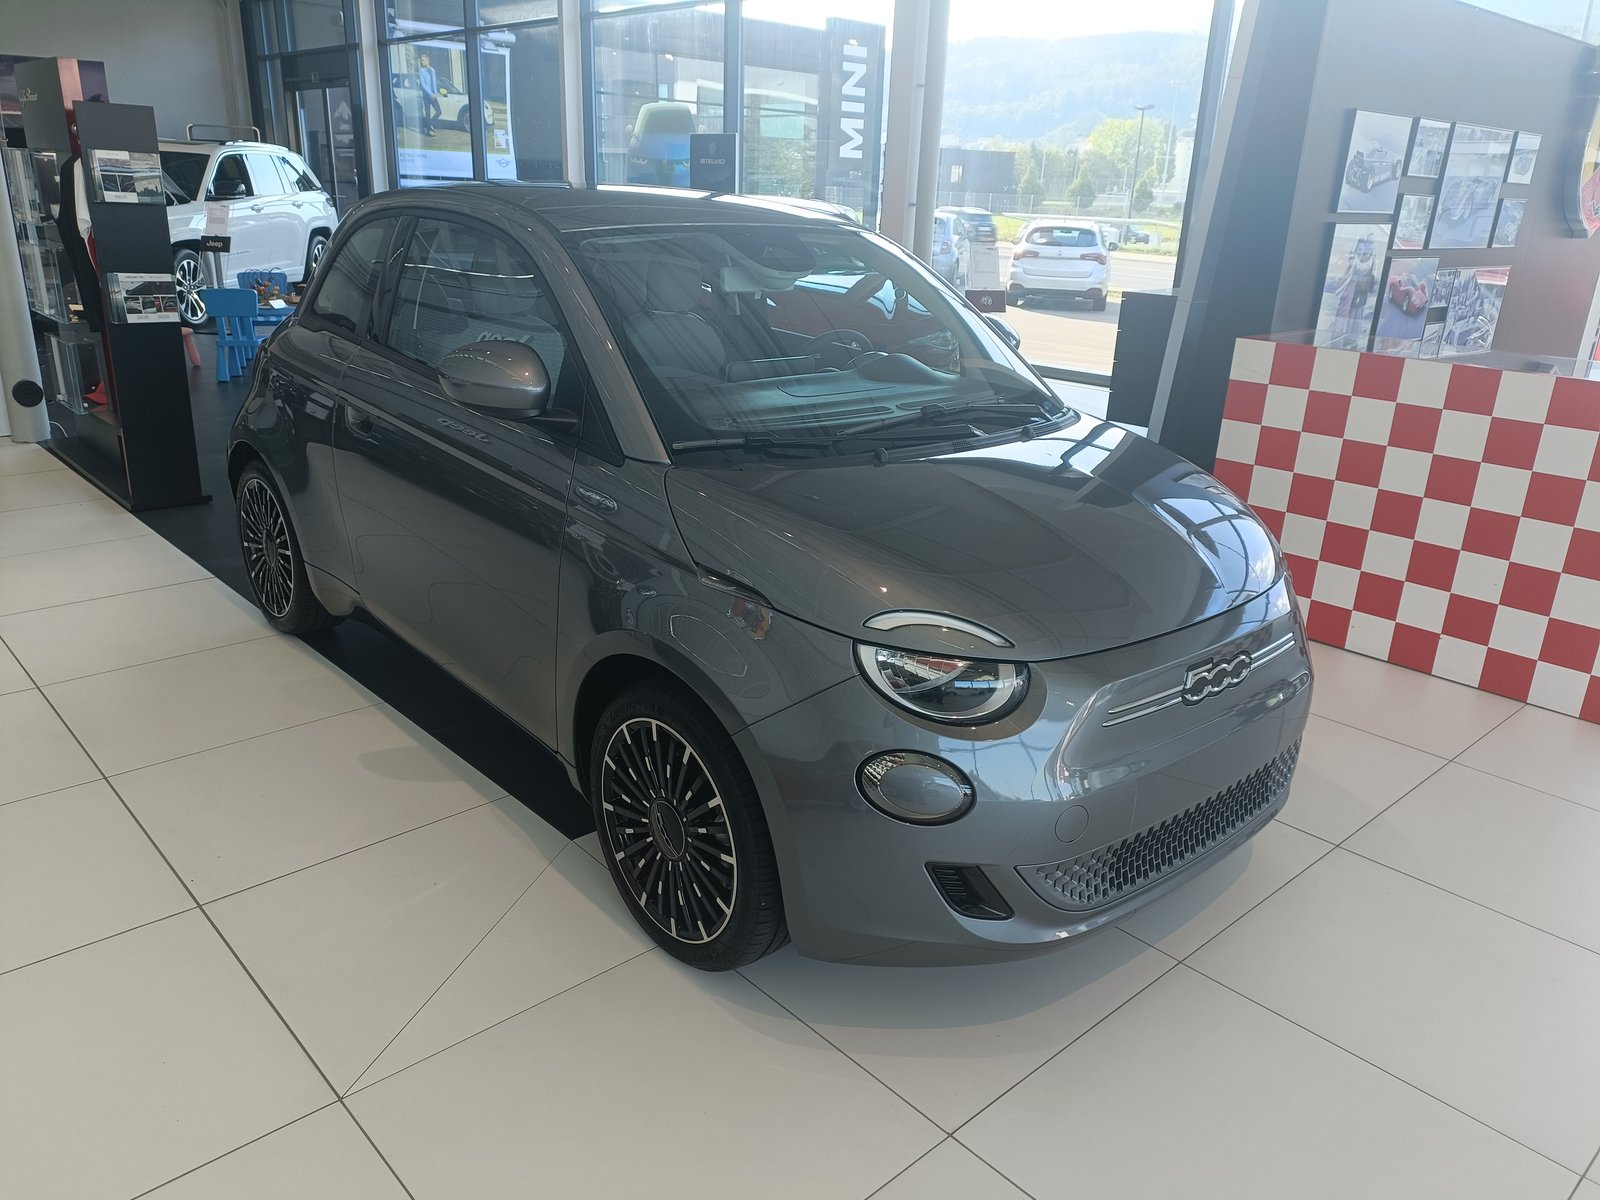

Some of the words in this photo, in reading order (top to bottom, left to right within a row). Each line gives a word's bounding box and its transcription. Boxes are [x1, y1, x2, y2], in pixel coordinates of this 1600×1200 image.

[839, 43, 868, 159] MINI
[206, 240, 224, 248] Jeep
[1182, 652, 1253, 705] 500
